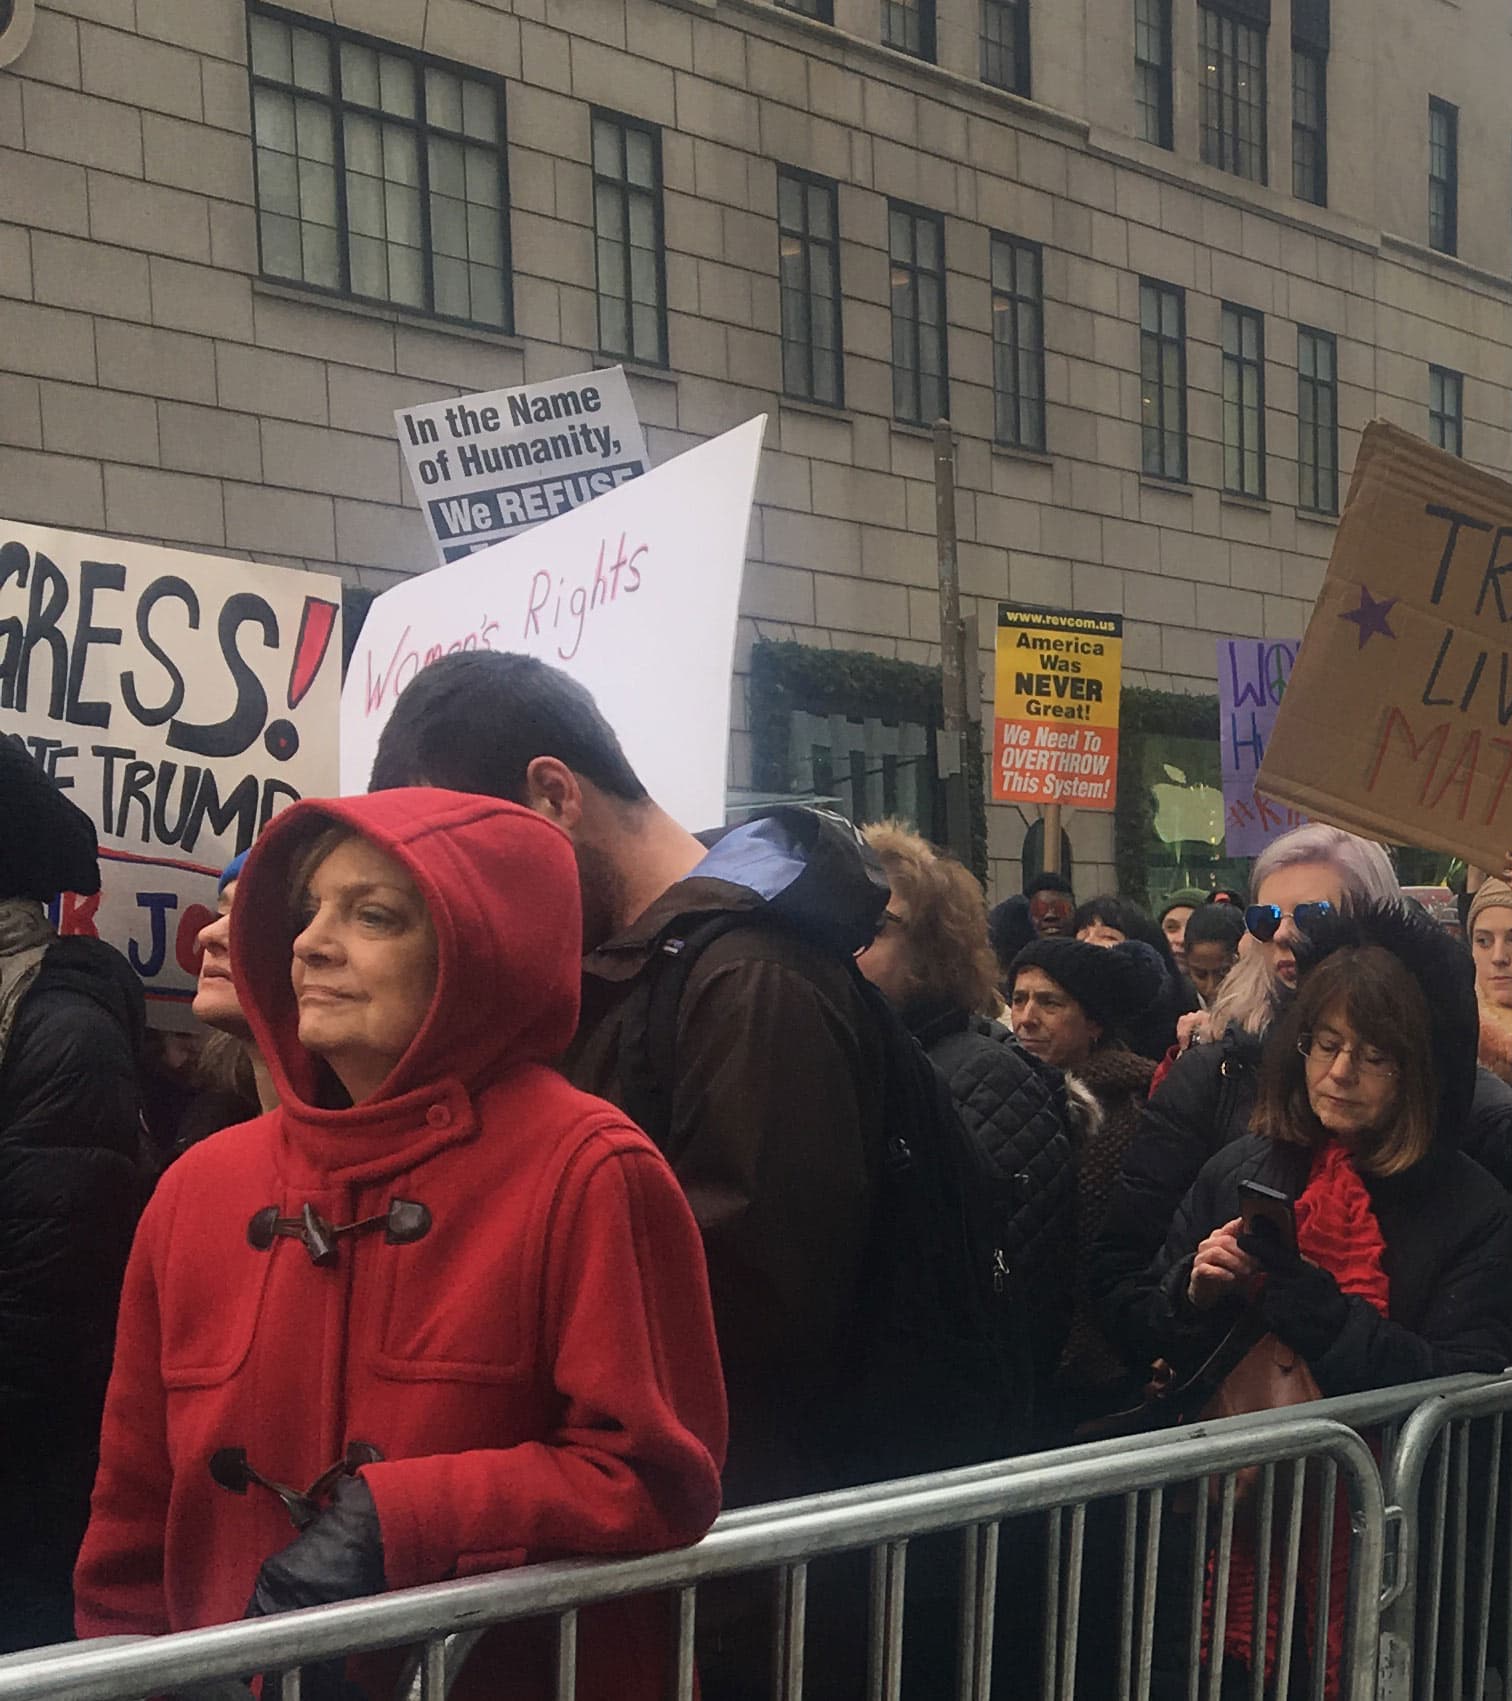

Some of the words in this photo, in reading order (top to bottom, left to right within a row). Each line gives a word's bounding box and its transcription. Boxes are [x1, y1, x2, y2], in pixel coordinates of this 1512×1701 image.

[405, 414, 439, 446] In
[445, 405, 500, 436] the
[506, 386, 602, 427] Name
[418, 451, 451, 485] of
[457, 424, 622, 478] Humanity,
[439, 501, 493, 536] We
[523, 531, 649, 661] Rights
[1006, 611, 1116, 632] www.revcom.us
[1016, 632, 1104, 656] America
[1040, 654, 1081, 673] Was
[1015, 672, 1103, 702] NEVER
[1026, 699, 1090, 721] Great!
[1003, 724, 1030, 746] We
[1035, 726, 1079, 750] Need
[1083, 731, 1102, 752] To
[1001, 748, 1110, 776] OVERTHROW
[1002, 772, 1039, 794] This
[1042, 774, 1111, 800] System!
